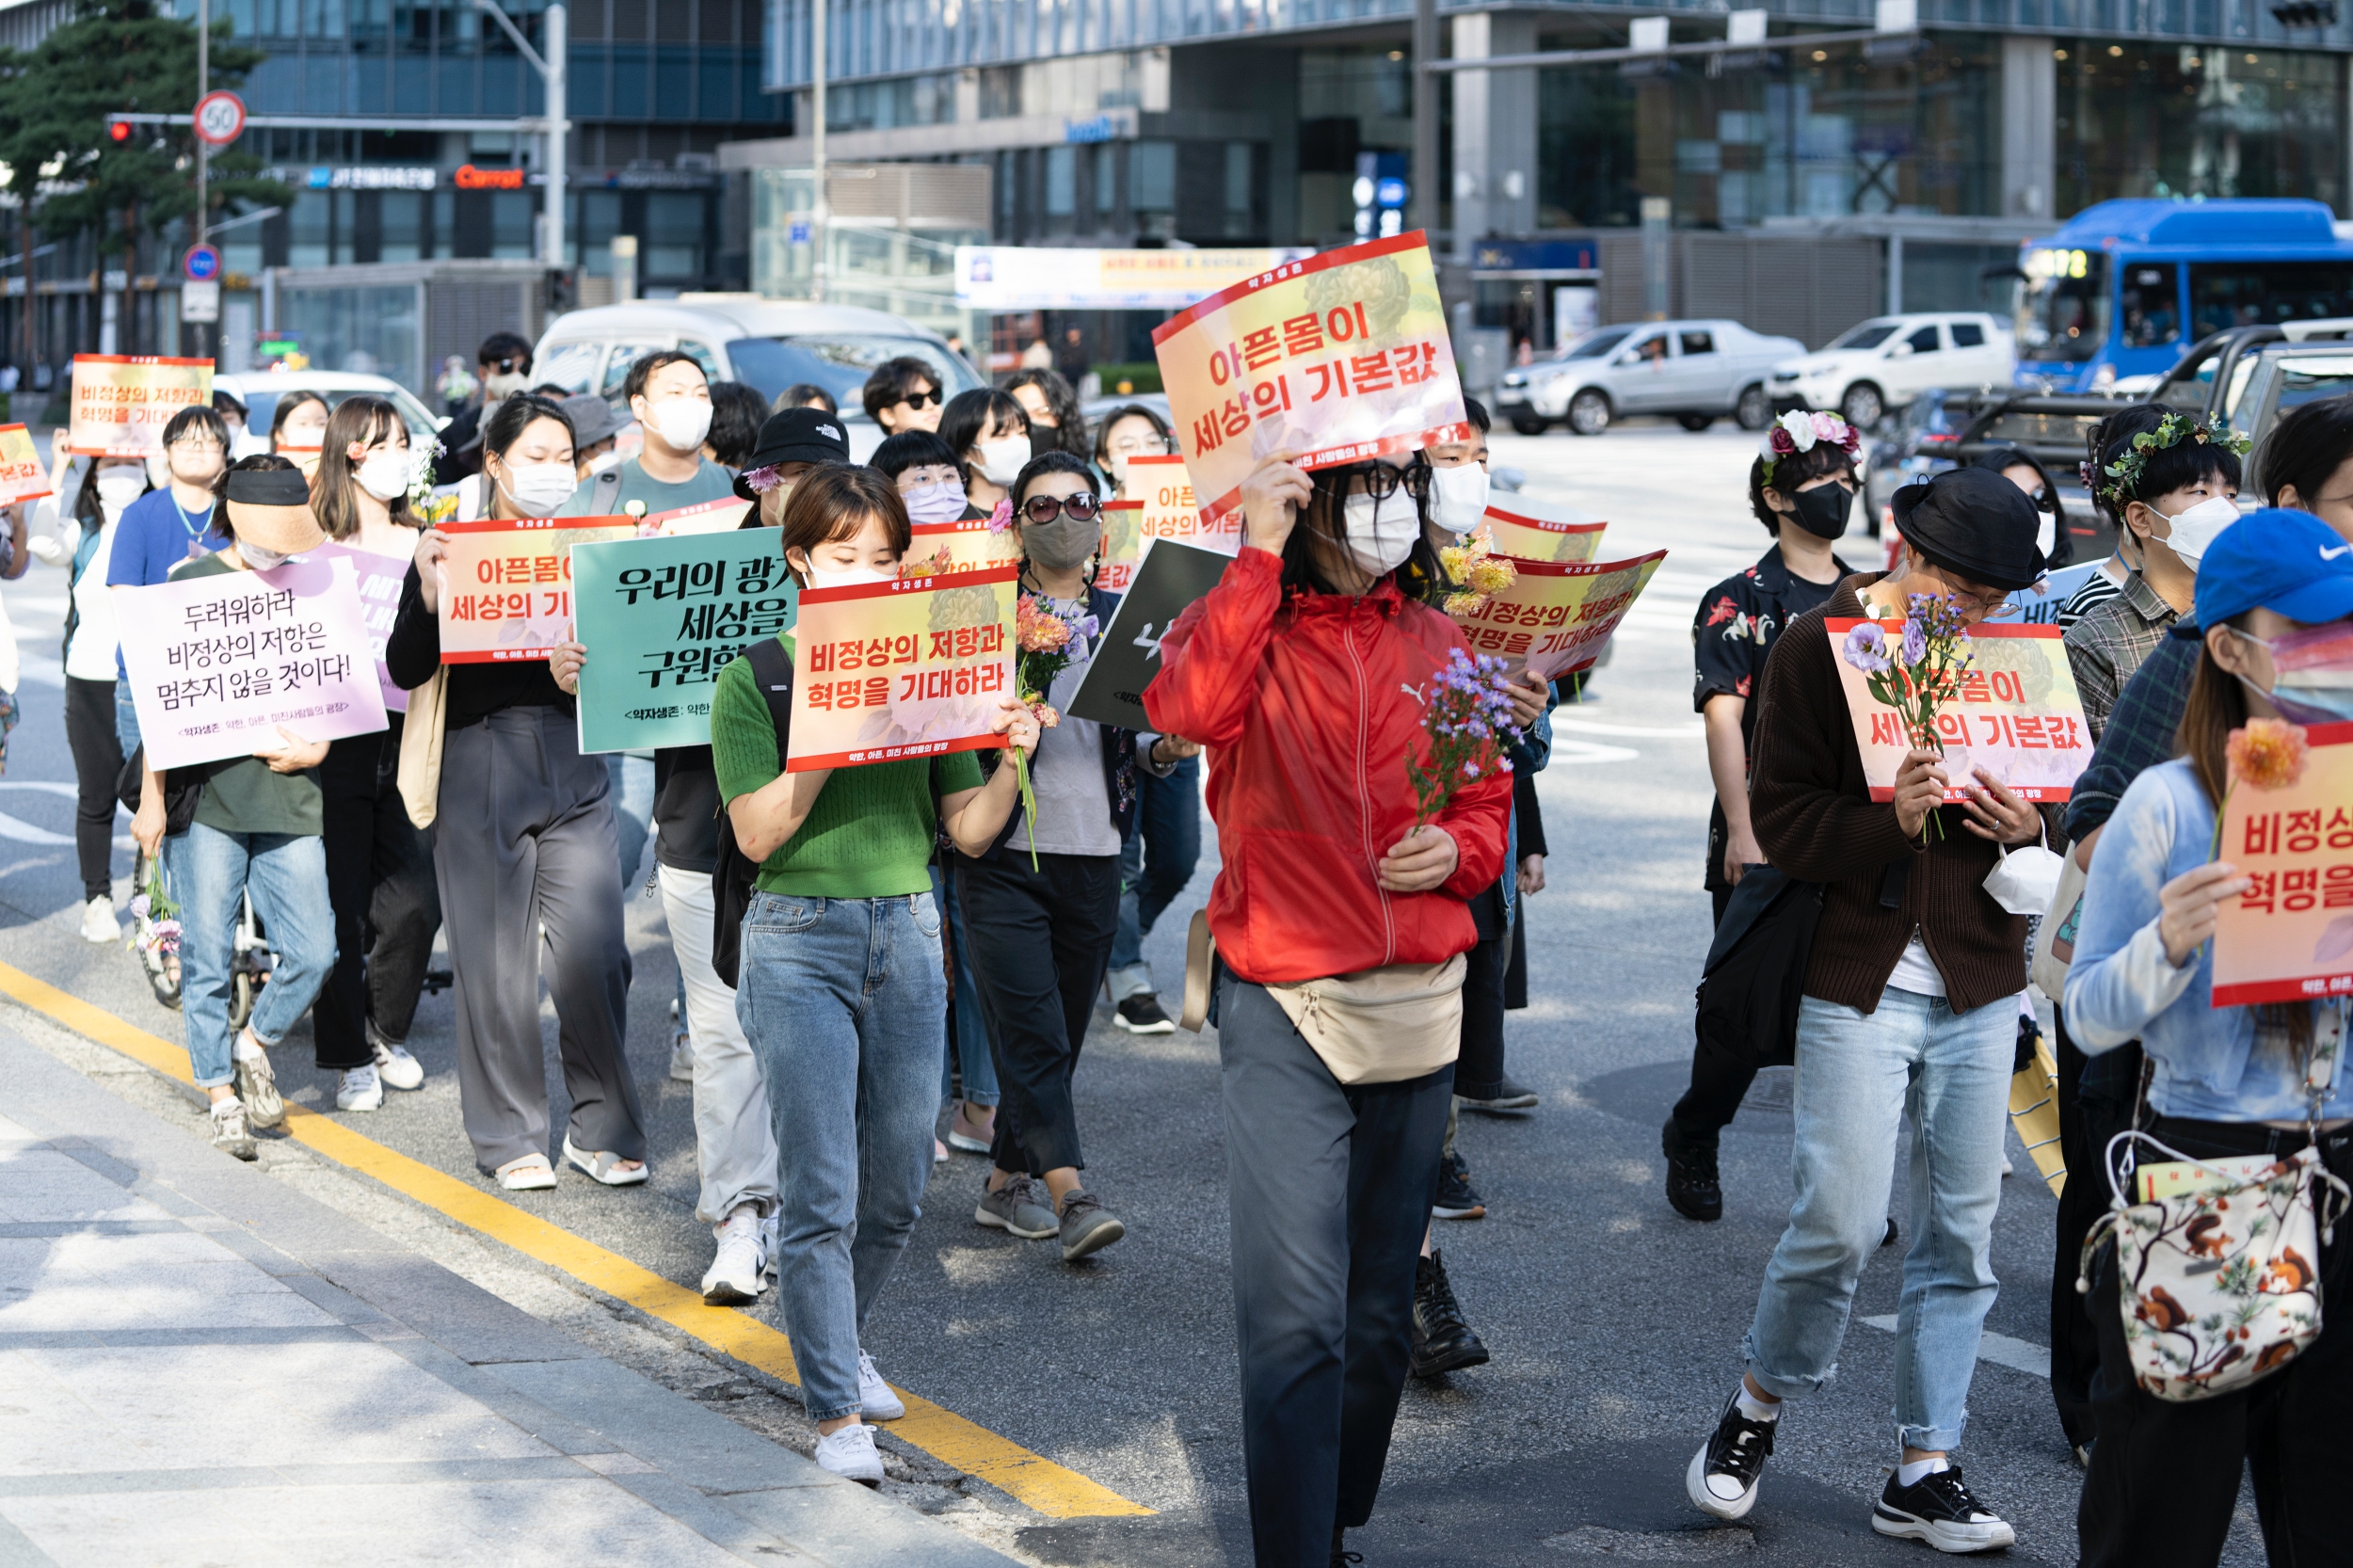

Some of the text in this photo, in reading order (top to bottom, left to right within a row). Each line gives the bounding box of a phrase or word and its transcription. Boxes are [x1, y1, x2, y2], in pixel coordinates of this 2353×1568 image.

[206, 104, 234, 130] 50
[455, 164, 523, 188] Carrot
[1209, 301, 1369, 387] 아픈몸이
[81, 386, 204, 405] 비정상의 저항과
[1193, 342, 1440, 459] 세상의 기본값
[81, 407, 129, 424] 혁명을
[1141, 515, 1196, 536] 세상의
[477, 555, 571, 584] 아픈몸
[616, 560, 727, 605] 우리의
[184, 588, 296, 632] 두려워하라
[451, 591, 572, 621] 세상의 기
[677, 598, 788, 642] 세상을
[1573, 588, 1635, 624] 저항과
[168, 632, 256, 671] 비정상의
[262, 621, 328, 656] 저항은
[810, 623, 1005, 673] 비정상의 저항과
[1537, 613, 1619, 655] 기대하라
[157, 654, 351, 712] 멈추지 않을 것이다!
[808, 662, 1005, 712] 혁명을 기대하라
[1978, 714, 2083, 750] 기본값
[848, 742, 949, 762] 약한, 아픈, 미친 사람들의 광장
